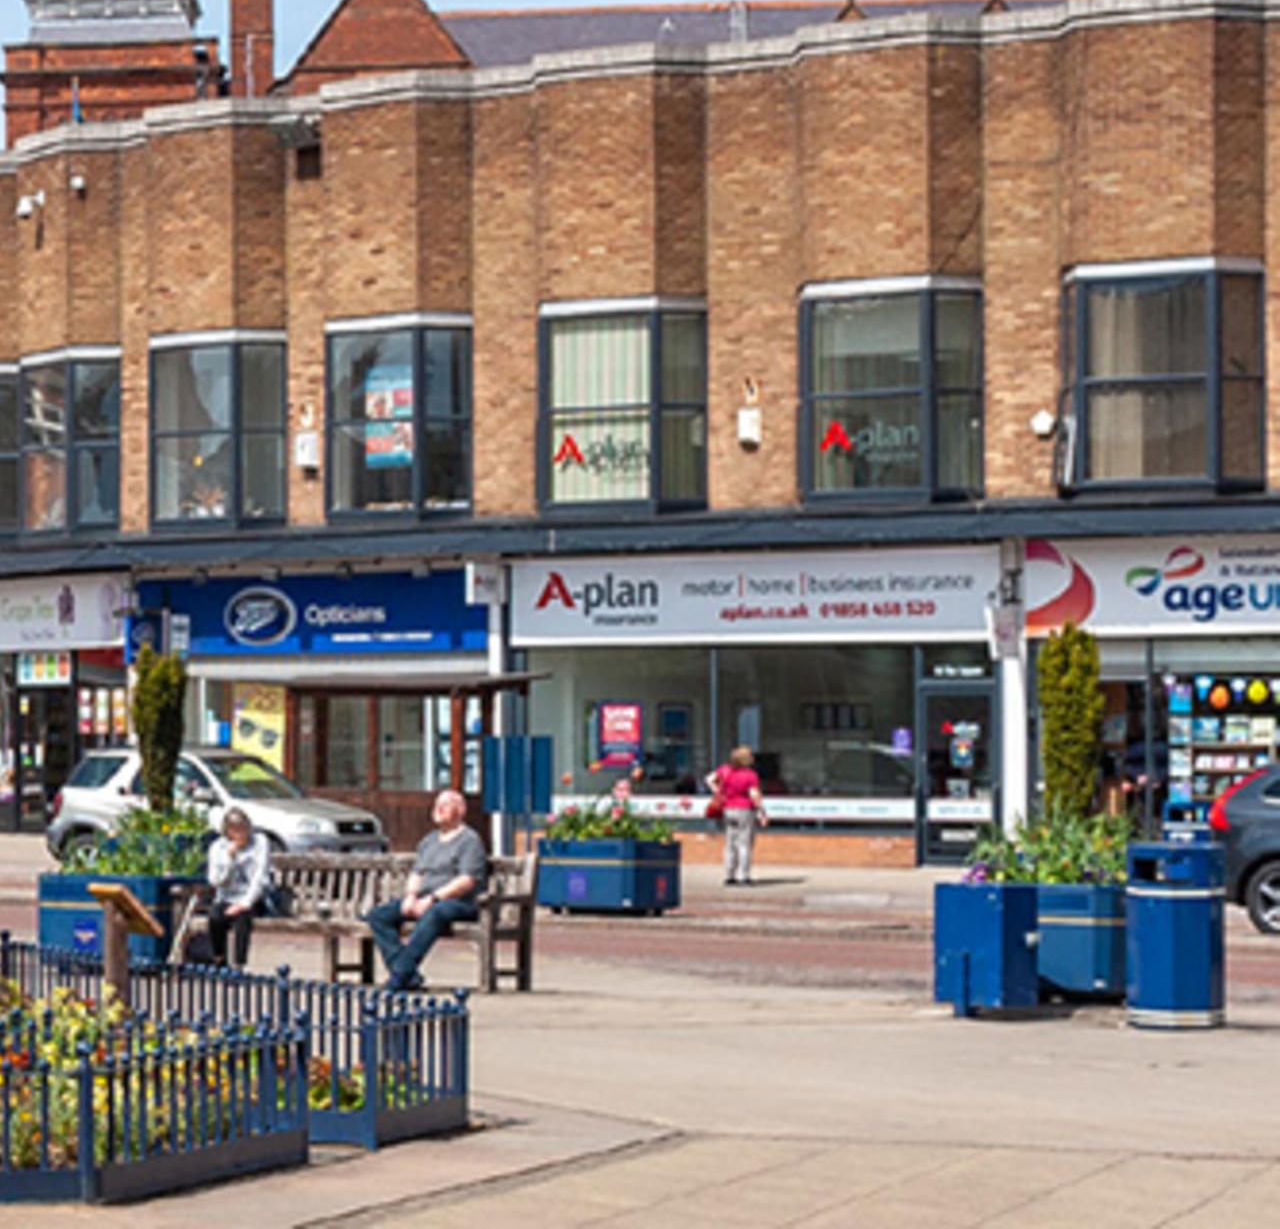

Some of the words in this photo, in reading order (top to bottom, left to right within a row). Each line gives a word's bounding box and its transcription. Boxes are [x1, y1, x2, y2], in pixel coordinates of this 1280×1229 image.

[535, 570, 659, 617] A-plan
[682, 578, 734, 596] motor
[748, 575, 794, 594] home
[808, 572, 884, 592] business
[889, 572, 974, 591] insurance
[304, 604, 386, 626] Opticians
[593, 615, 659, 625] insurance
[719, 603, 809, 622] aplan.co.uk
